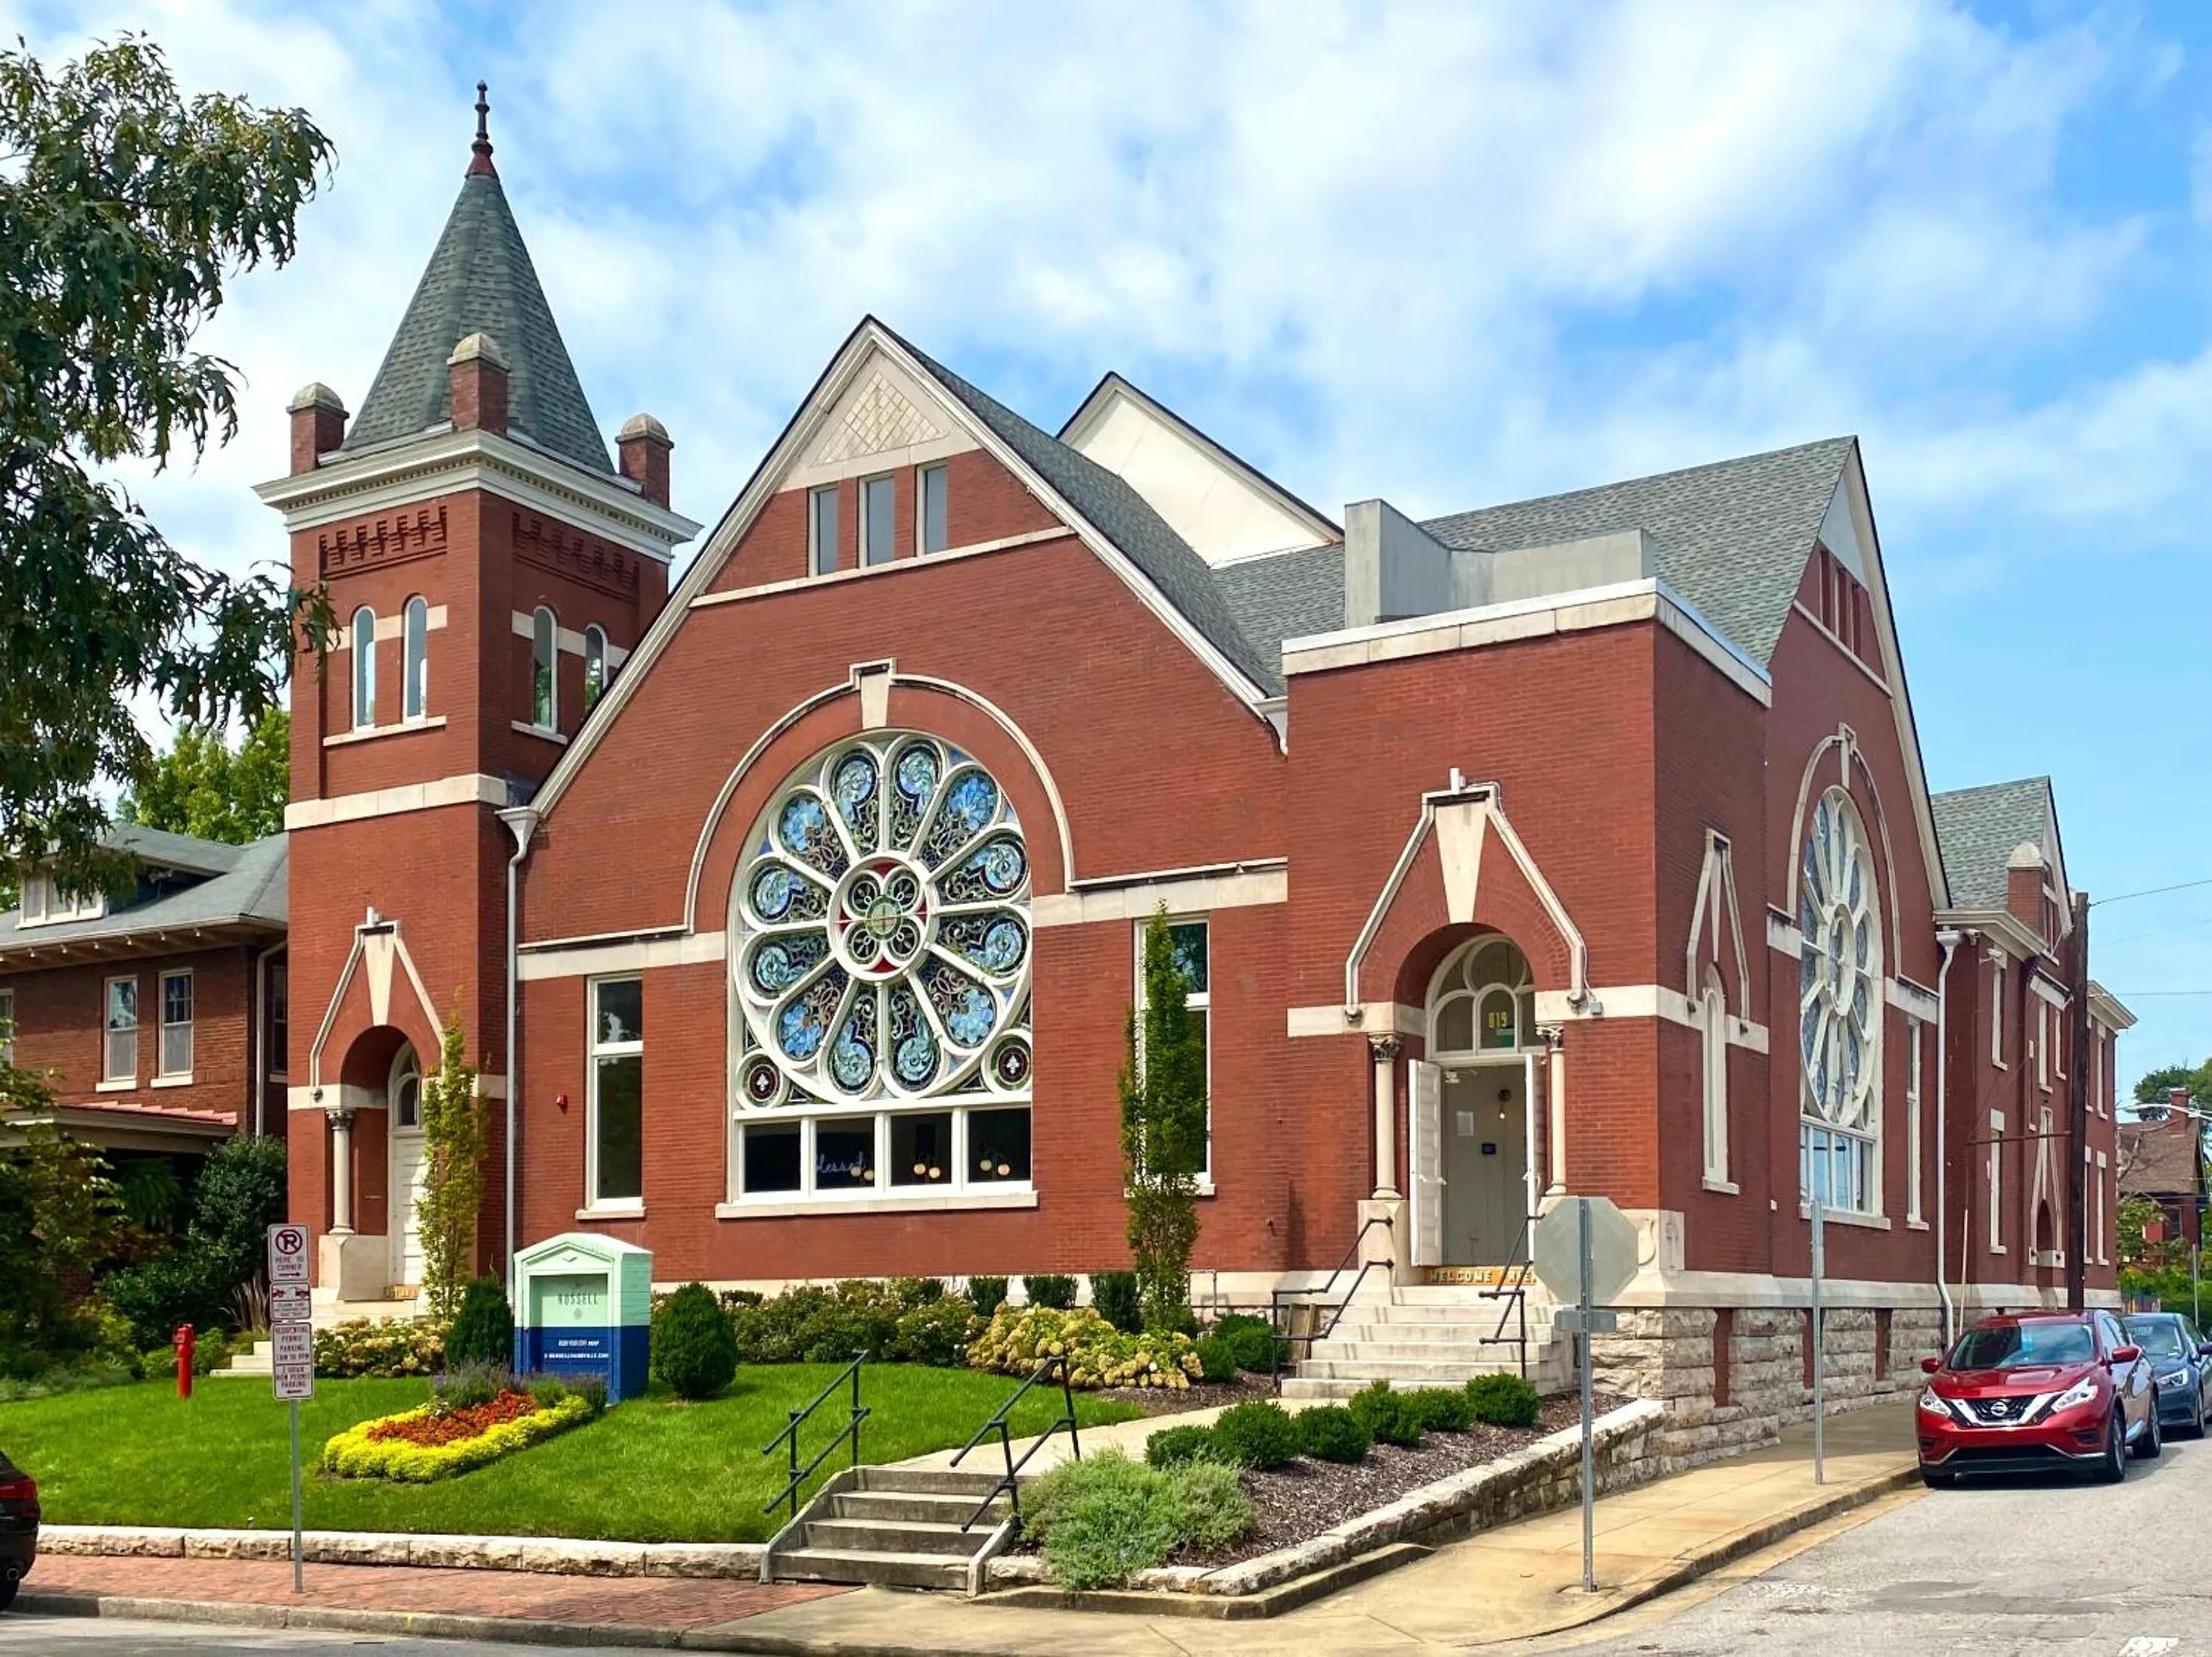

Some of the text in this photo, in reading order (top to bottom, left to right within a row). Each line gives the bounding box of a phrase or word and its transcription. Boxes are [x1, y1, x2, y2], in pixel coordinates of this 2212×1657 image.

[1430, 1269, 1492, 1283] WELCOME
[558, 1292, 598, 1305] RUSSELL
[280, 1380, 306, 1389] PARKING
